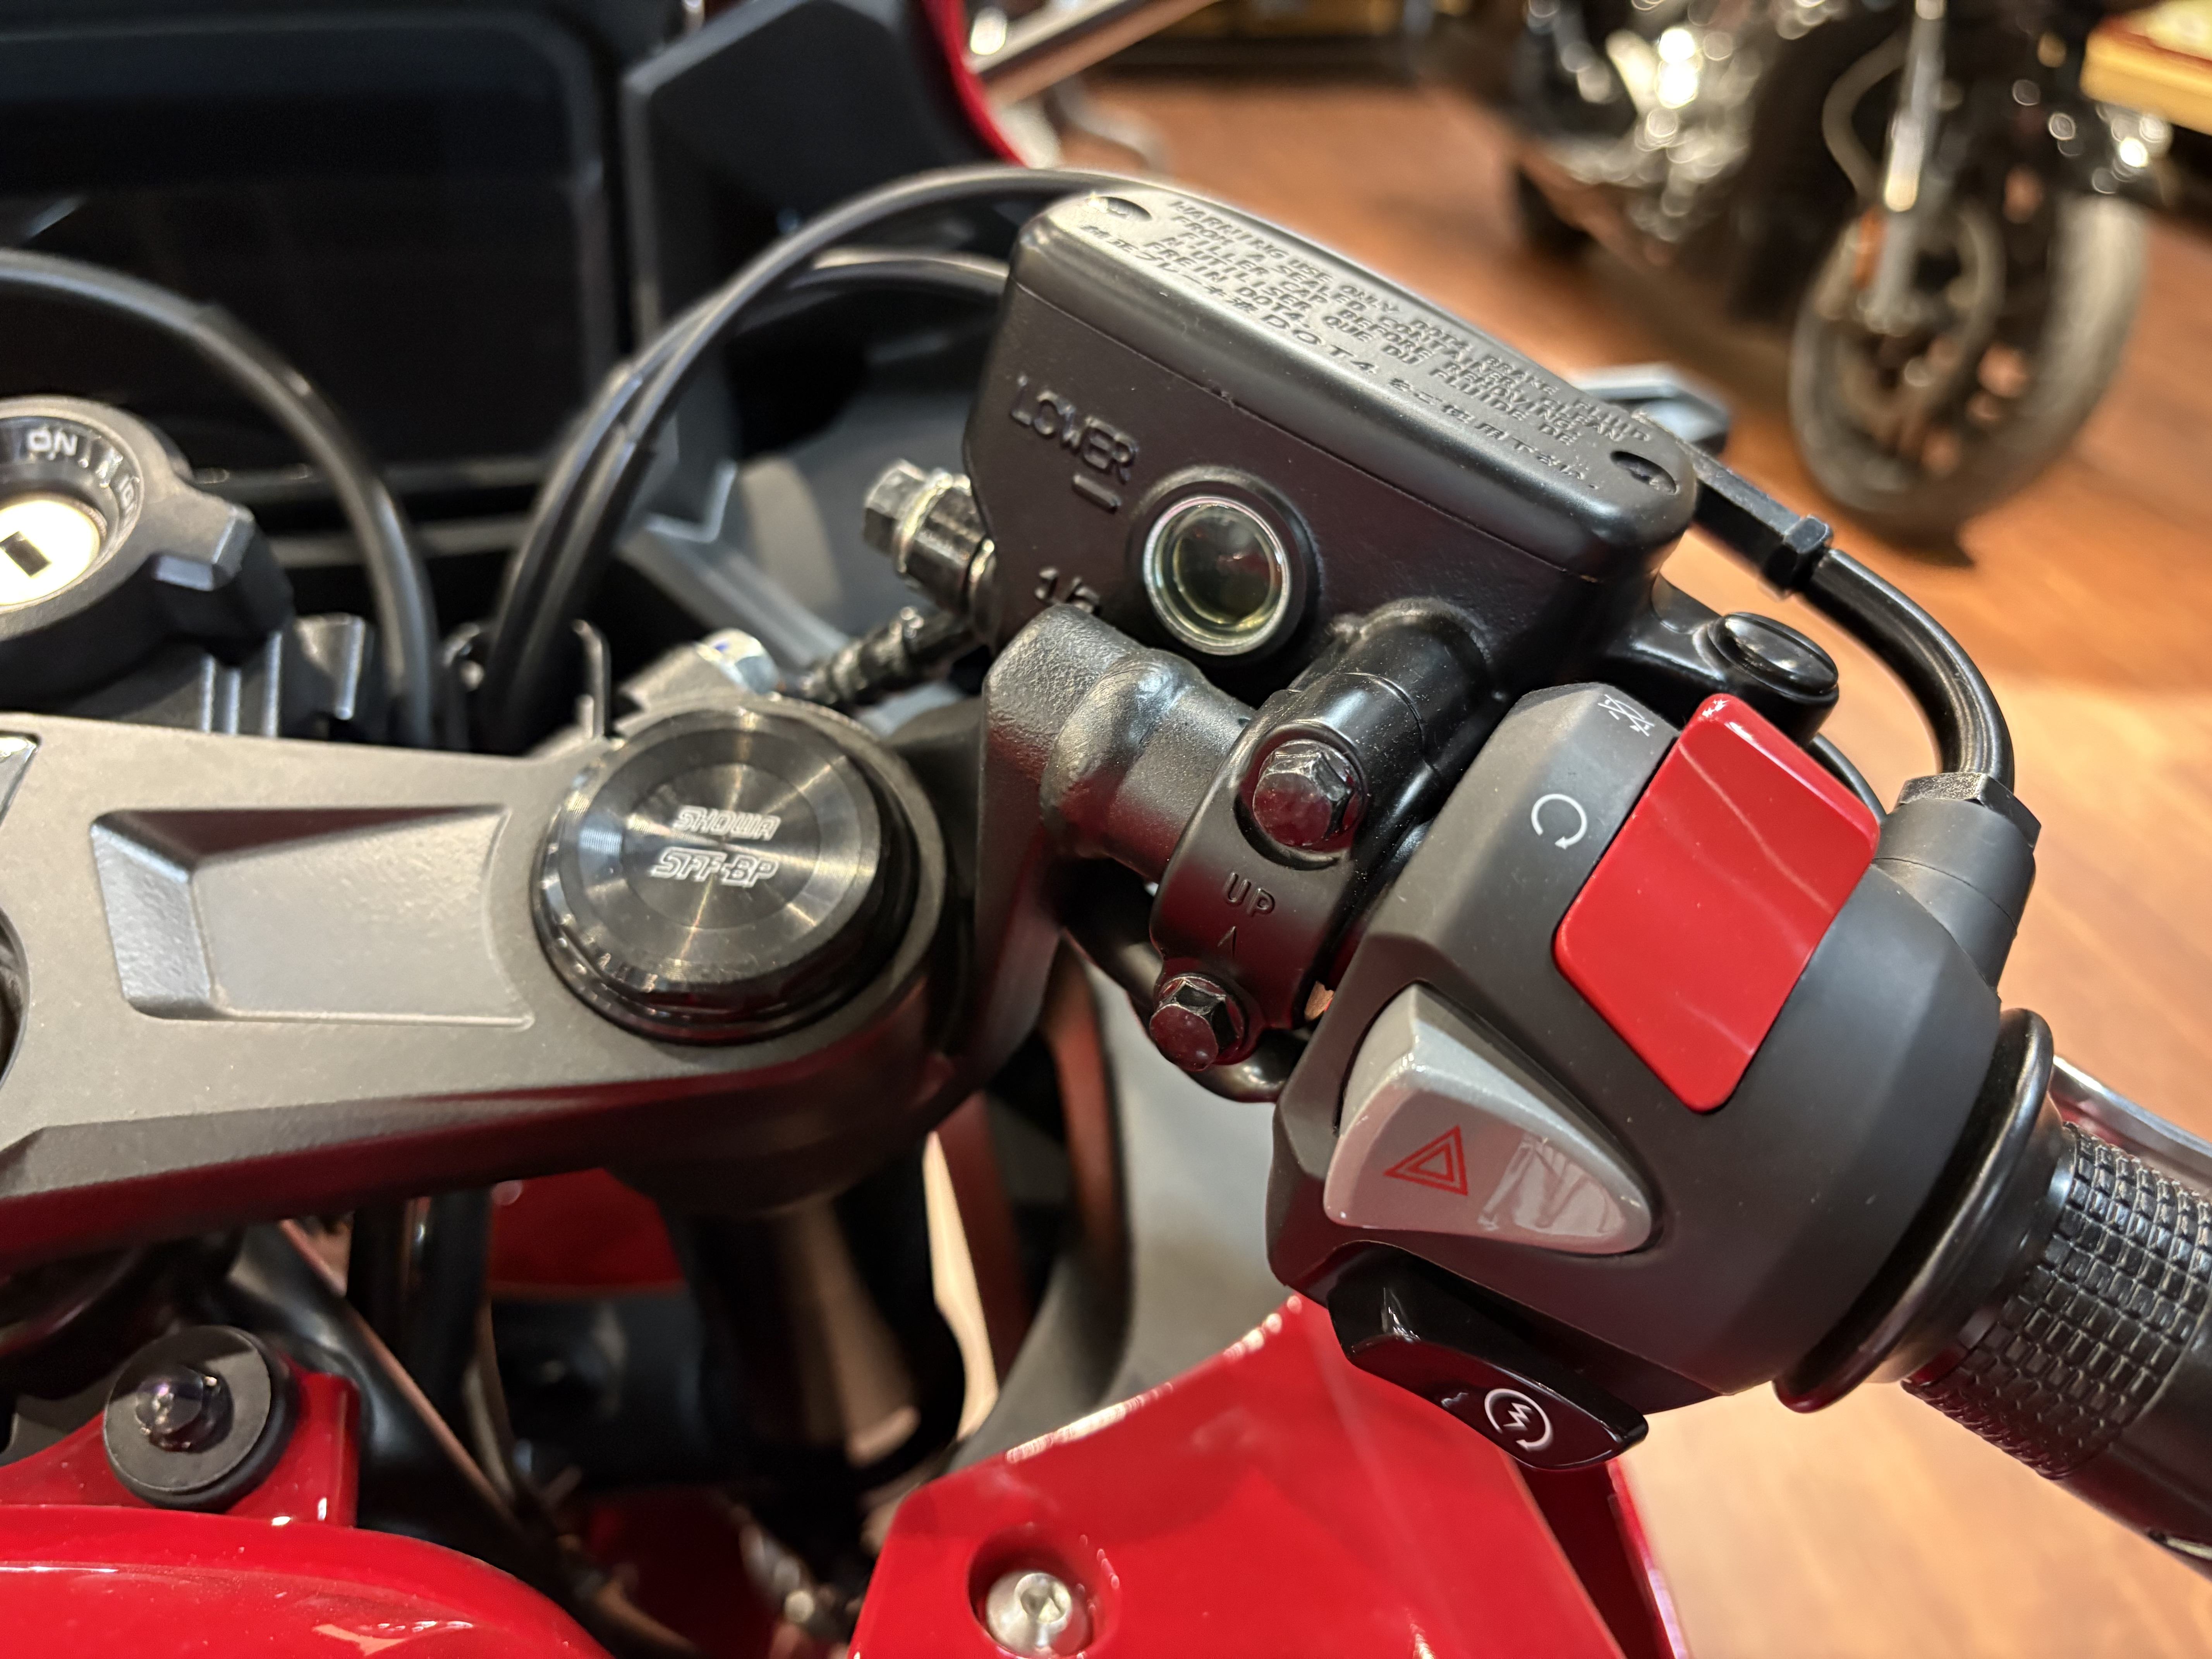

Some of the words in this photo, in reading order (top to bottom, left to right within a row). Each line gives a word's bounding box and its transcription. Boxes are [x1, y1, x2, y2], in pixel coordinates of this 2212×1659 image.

[1141, 240, 1229, 284] FREIN
[1167, 200, 1291, 261] WARNING
[1285, 258, 1334, 283] USE
[1408, 318, 1472, 352] DOT4
[1169, 214, 1236, 247] FROM
[1245, 251, 1269, 263] A
[1269, 263, 1370, 314] SEALED
[1176, 231, 1273, 278] FILLER
[1276, 279, 1331, 307] CAP
[1335, 308, 1436, 360] BEFORE
[1316, 314, 1376, 345] QUE
[1379, 343, 1422, 367] DU
[1426, 367, 1530, 422] FLUIDE
[1535, 422, 1577, 446] DE
[27, 428, 78, 457] ON
[1011, 374, 1139, 483] LOWER
[672, 805, 781, 841] SHOWA
[651, 847, 779, 888] SFF-BP
[1223, 871, 1276, 917] UP
